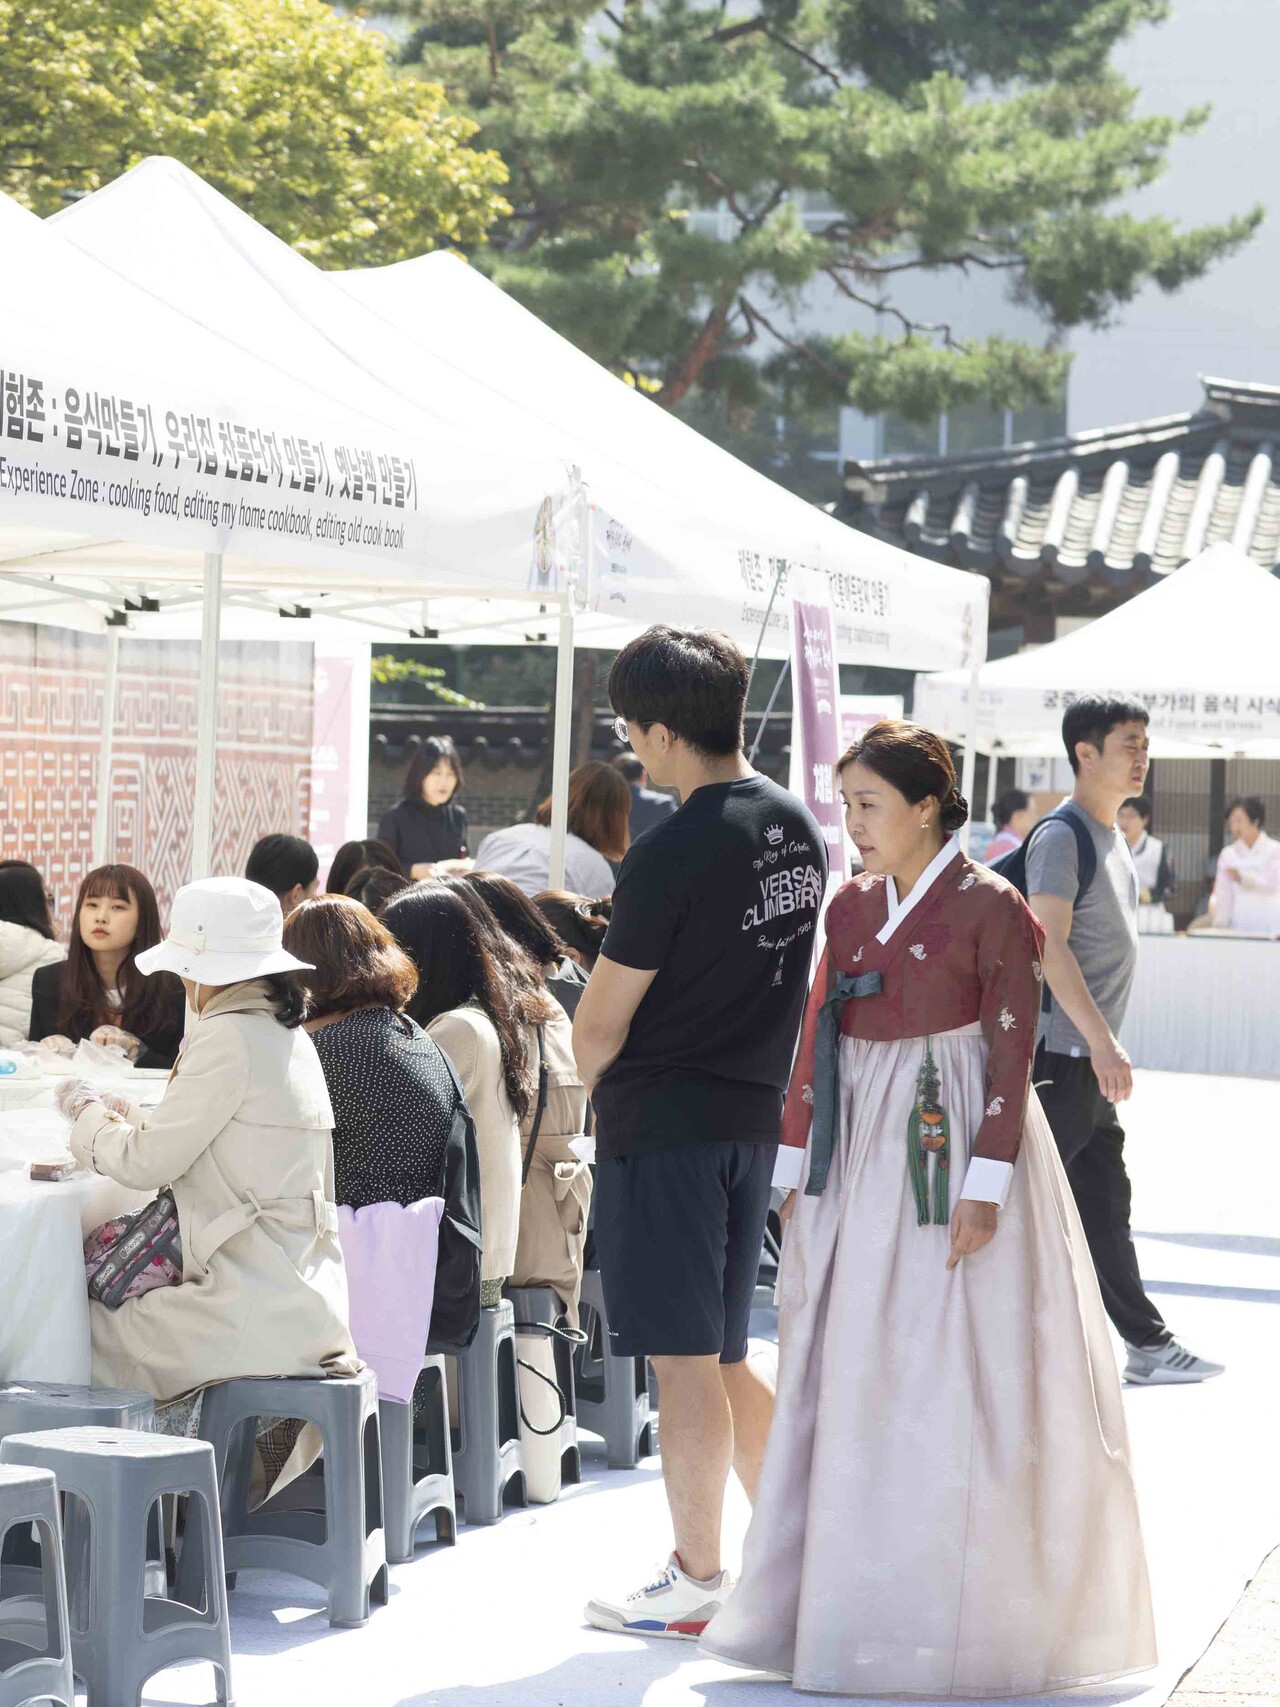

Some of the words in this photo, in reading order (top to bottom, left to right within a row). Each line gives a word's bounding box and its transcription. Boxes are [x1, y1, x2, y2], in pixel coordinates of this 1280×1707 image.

[64, 387, 164, 468] 음식만들기,
[165, 410, 218, 476] 우리집
[219, 421, 283, 488] 찬품단자
[283, 435, 334, 498] 만들기,
[334, 446, 377, 504] 옛날책
[377, 453, 418, 510] 만들기
[0, 456, 67, 498] Experience
[70, 469, 99, 504] Zone
[108, 477, 151, 517] cooking
[154, 482, 181, 521] food,
[183, 488, 220, 527] editing
[221, 500, 237, 529] my
[239, 497, 266, 529] home
[267, 504, 314, 542] cookbook,
[315, 512, 346, 546] editing
[347, 515, 363, 543] old
[363, 520, 383, 547] cook
[384, 523, 405, 550] book
[1204, 695, 1239, 715] 음식
[759, 865, 818, 900] VERSA
[742, 886, 817, 931] CLIMBER
